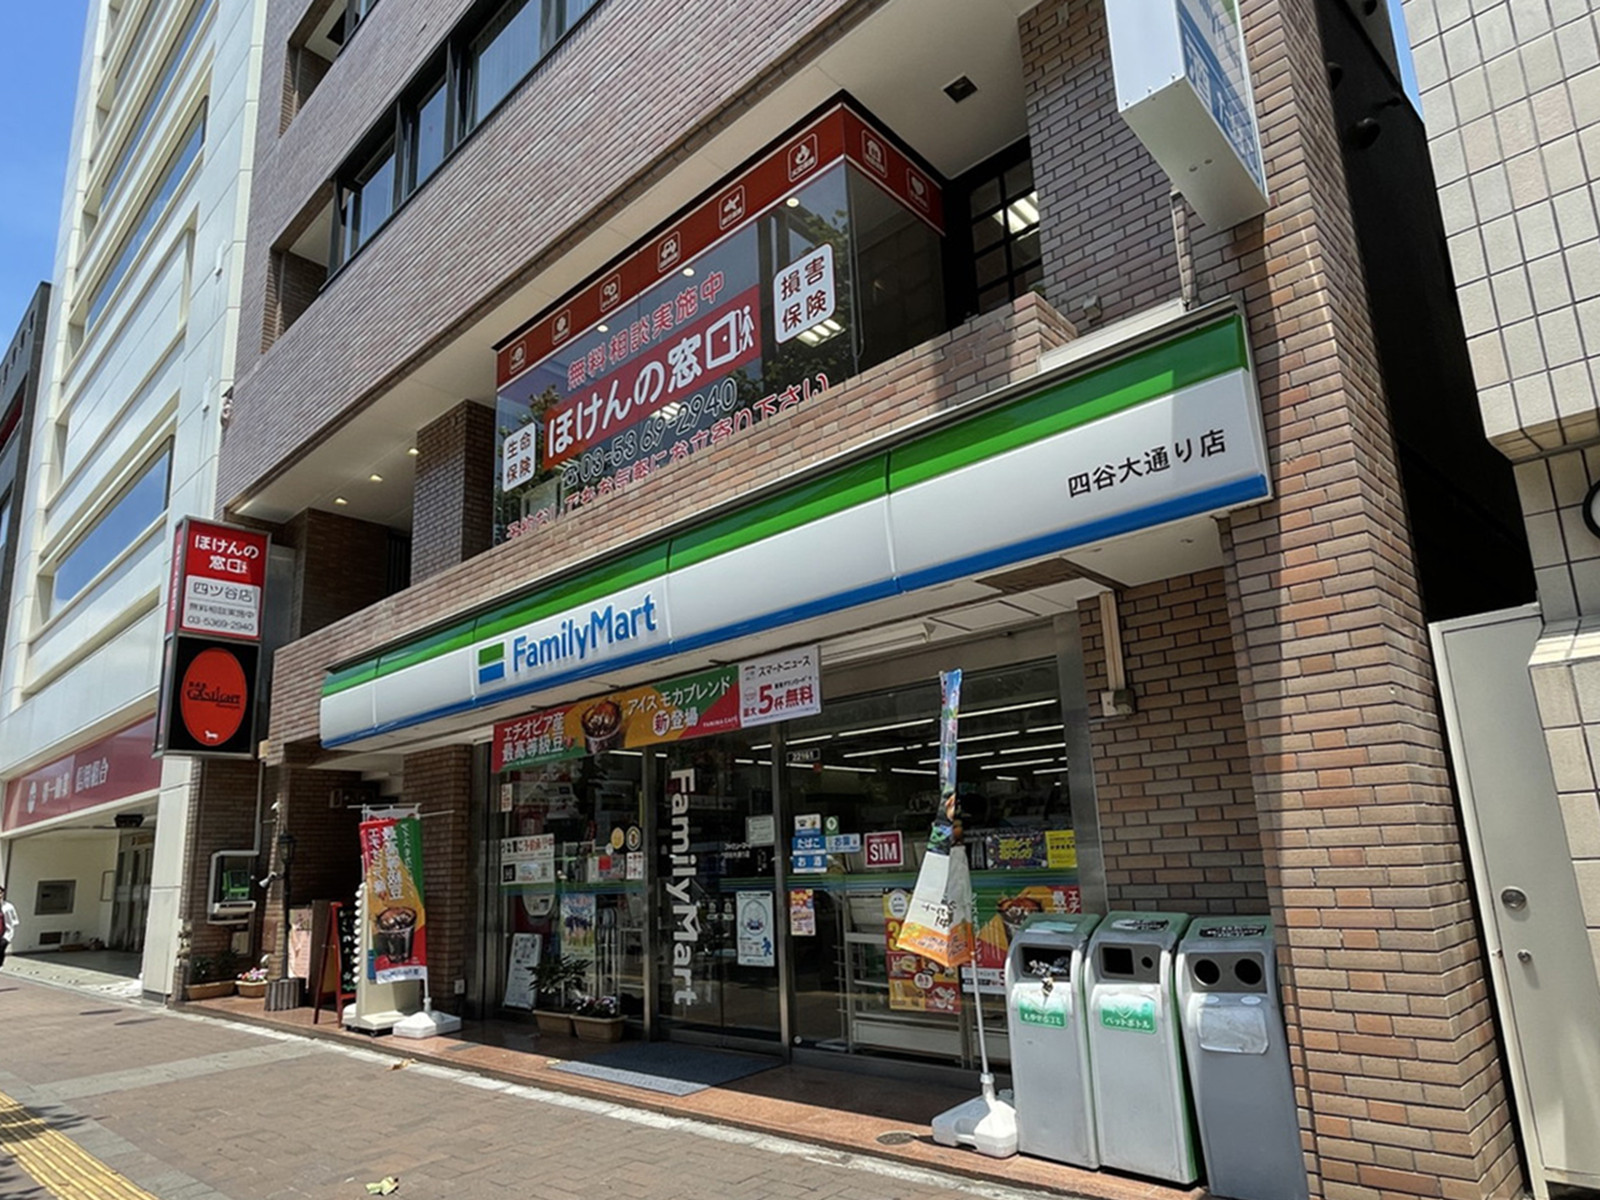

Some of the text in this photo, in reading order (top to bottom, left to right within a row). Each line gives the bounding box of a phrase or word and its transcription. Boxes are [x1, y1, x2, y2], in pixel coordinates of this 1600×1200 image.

[780, 255, 826, 302] 損害
[781, 289, 827, 332] 保険
[567, 272, 725, 391] 無料相談実施中
[548, 308, 740, 458] ほけんの窓口
[506, 431, 532, 463] 生命
[580, 377, 738, 484] 03-5369-2940
[506, 454, 532, 485] 保険
[1068, 429, 1226, 498] 四谷大通り店
[195, 534, 259, 560] ほけんの
[193, 581, 253, 604] 四ツ谷店
[513, 594, 657, 673] FamilyMart
[758, 655, 811, 677] スマートニュース
[628, 674, 731, 717] アイス モカブレンド
[503, 712, 565, 742] エチオピア産
[654, 705, 699, 732] 新登場
[869, 843, 898, 862] SIM
[666, 768, 699, 1006] FamilyMart
[1104, 1016, 1151, 1031] ペットボトル
